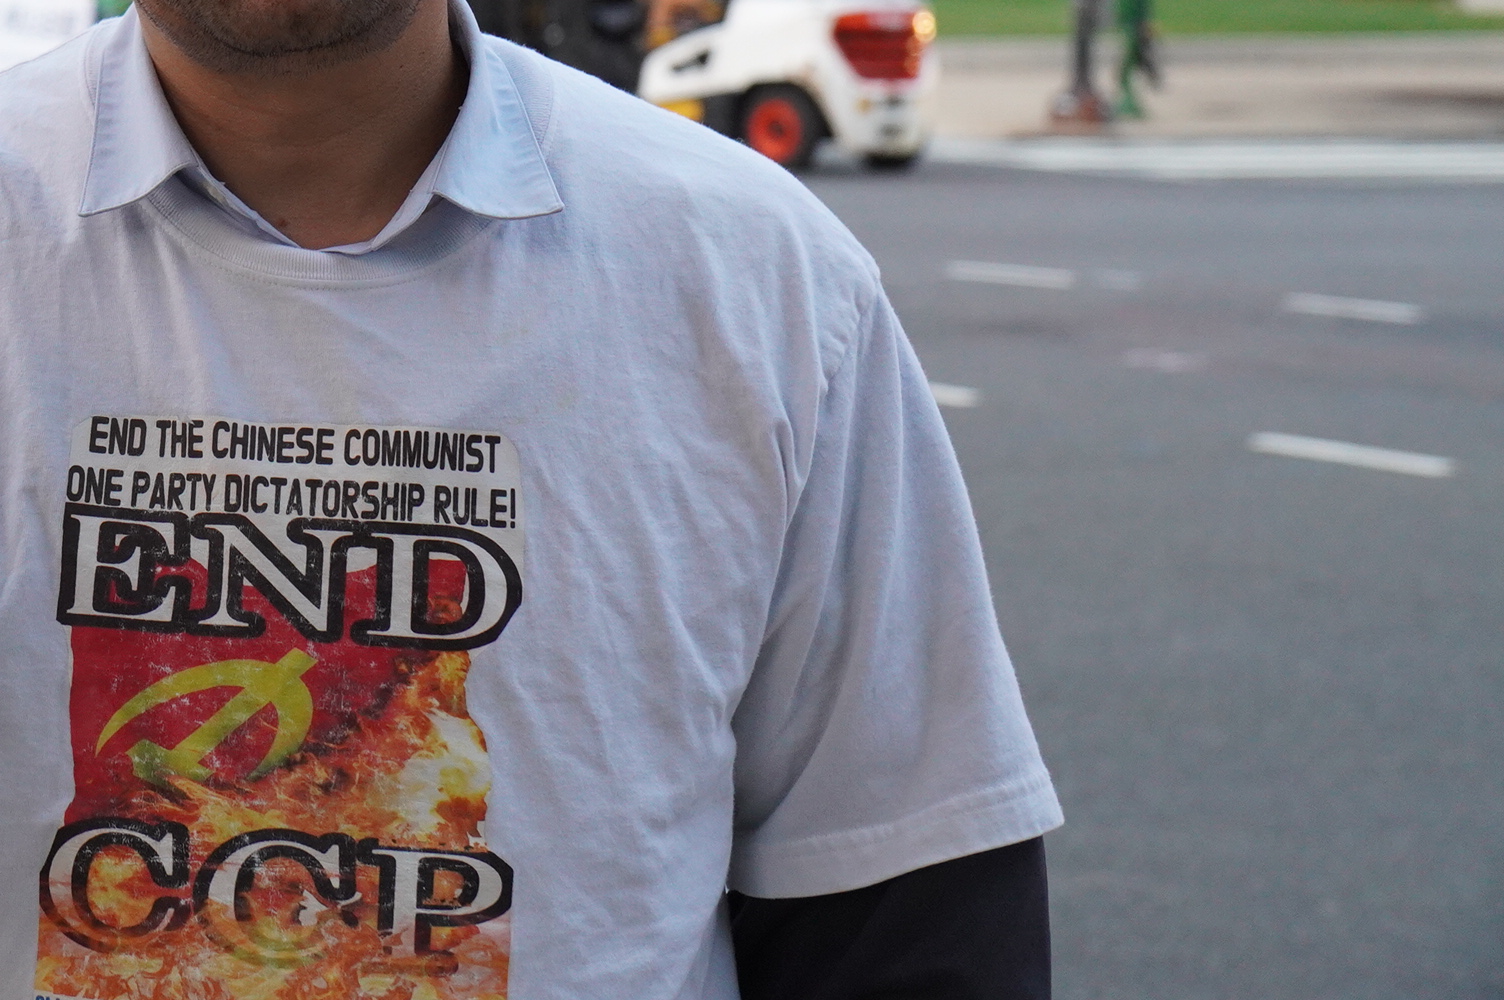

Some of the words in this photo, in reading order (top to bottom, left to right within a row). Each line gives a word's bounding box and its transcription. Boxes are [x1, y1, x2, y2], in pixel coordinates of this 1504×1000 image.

[66, 465, 124, 507] ONE
[130, 471, 217, 512] PARTY
[224, 474, 426, 522] DICTATORSHIP
[433, 484, 516, 529] RULE!
[89, 416, 148, 456] END
[156, 419, 204, 459] THE
[212, 420, 335, 465] CHINESE
[344, 428, 501, 473] COMMUNIST
[56, 502, 523, 651] END
[39, 816, 514, 977] CCP
